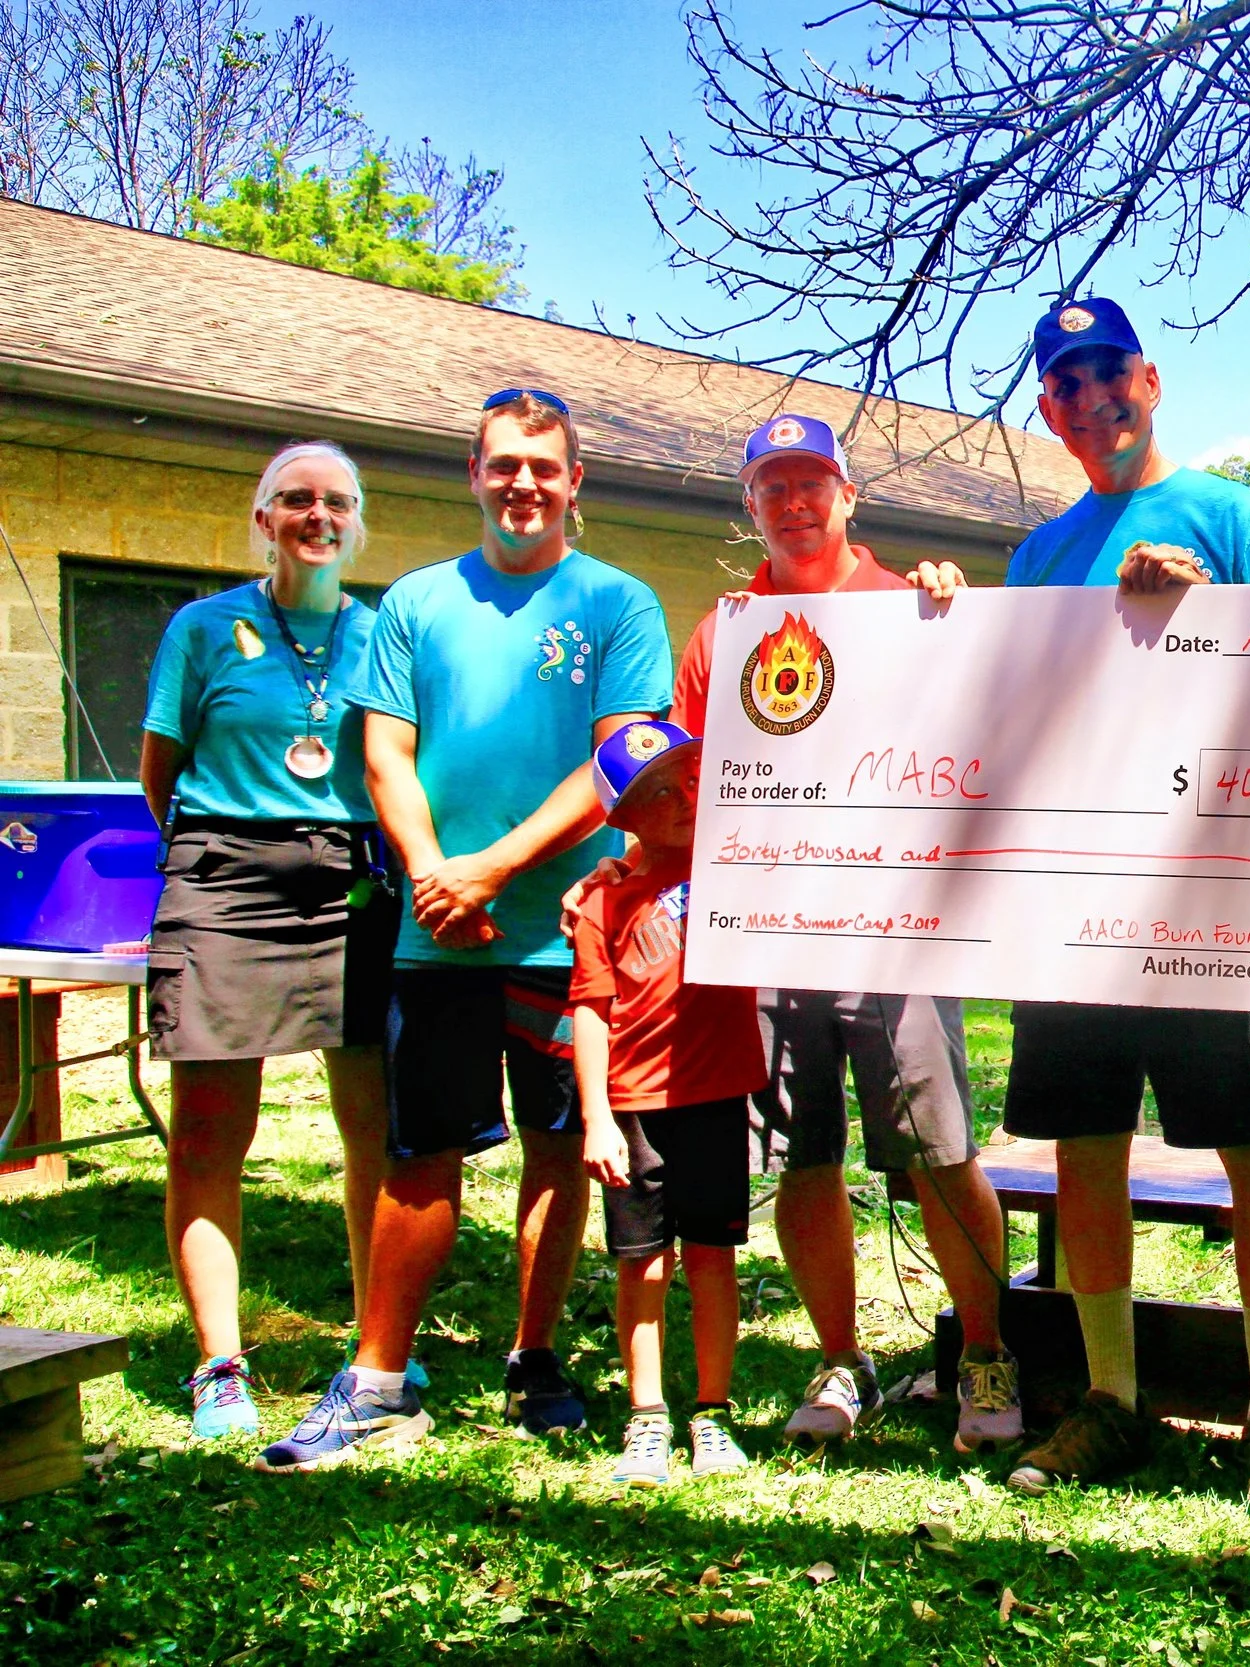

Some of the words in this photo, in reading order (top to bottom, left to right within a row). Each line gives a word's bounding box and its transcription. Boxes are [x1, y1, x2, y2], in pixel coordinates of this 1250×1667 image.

[1165, 634, 1220, 653] Date:
[743, 652, 759, 678] ANNE
[816, 650, 834, 713] FOUNDATION
[742, 680, 759, 721] ARUNDEL
[771, 701, 798, 713] 1563
[758, 718, 793, 734] COUNTY
[794, 711, 818, 731] BURN
[721, 760, 751, 780] Pay
[756, 761, 773, 776] to
[847, 747, 989, 799] MABC
[1172, 765, 1189, 796] $
[720, 783, 747, 800] the
[751, 783, 799, 800] order
[803, 782, 827, 800] of:
[901, 845, 941, 862] and
[709, 911, 741, 929] For:
[793, 912, 853, 930] Summer
[854, 912, 893, 934] Camp
[900, 913, 940, 931] 2019
[1150, 920, 1204, 943] Burn
